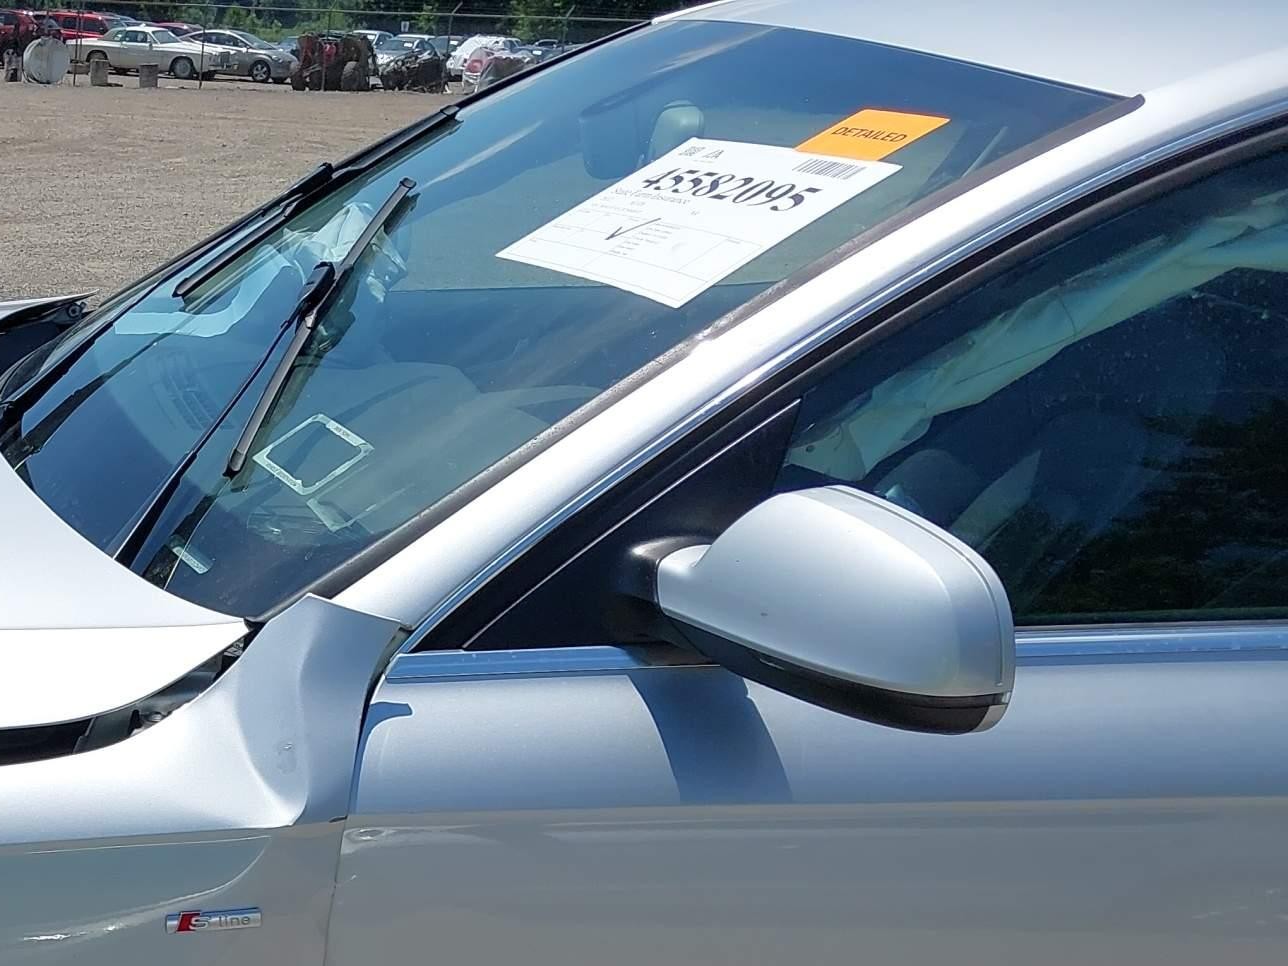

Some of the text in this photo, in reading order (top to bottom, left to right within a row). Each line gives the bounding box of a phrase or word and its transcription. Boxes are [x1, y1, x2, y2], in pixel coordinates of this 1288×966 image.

[831, 126, 908, 143] DETAILED
[641, 167, 825, 212] 45582095
[218, 914, 251, 928] line
